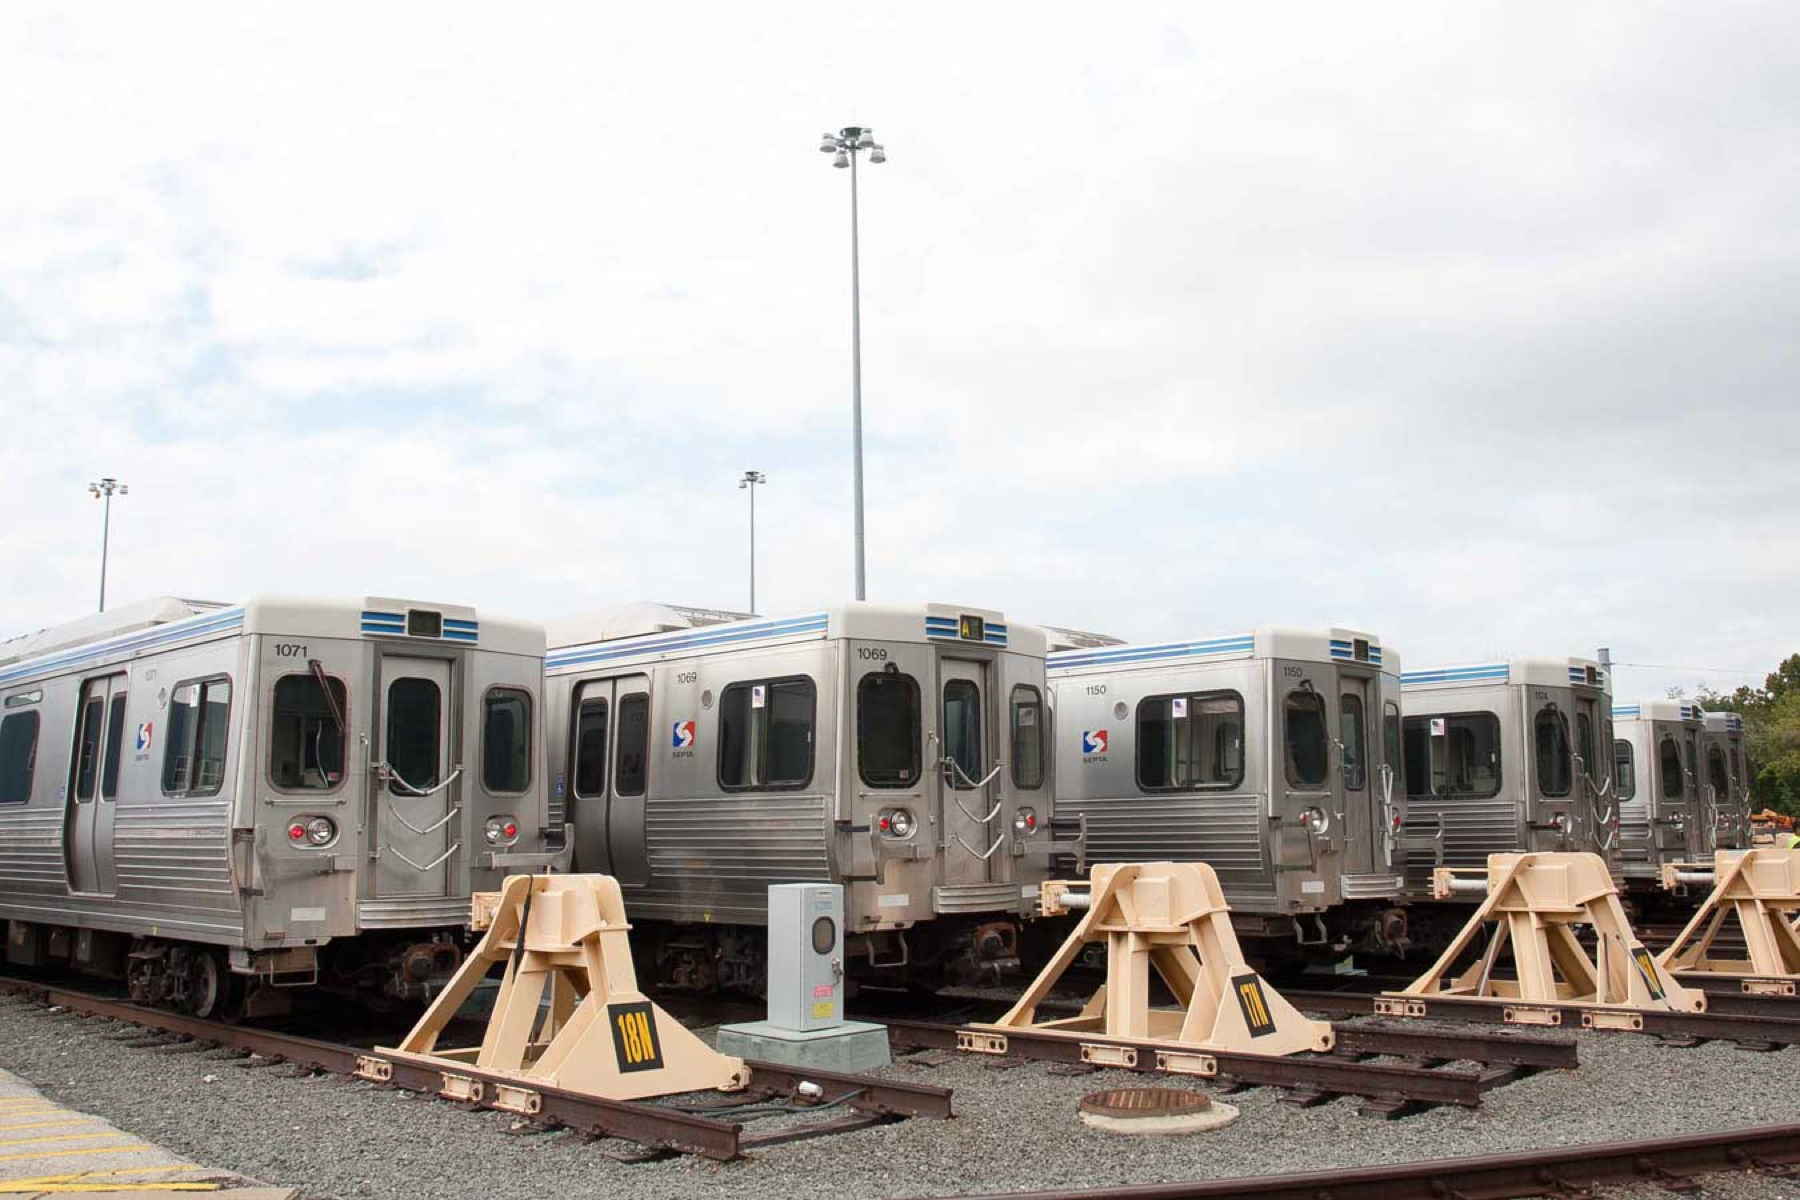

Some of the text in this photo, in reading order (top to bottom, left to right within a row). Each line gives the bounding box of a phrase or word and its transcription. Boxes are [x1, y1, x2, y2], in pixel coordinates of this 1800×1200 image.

[274, 643, 308, 659] 1071
[857, 647, 888, 661] 1069
[1086, 684, 1107, 696] 1150
